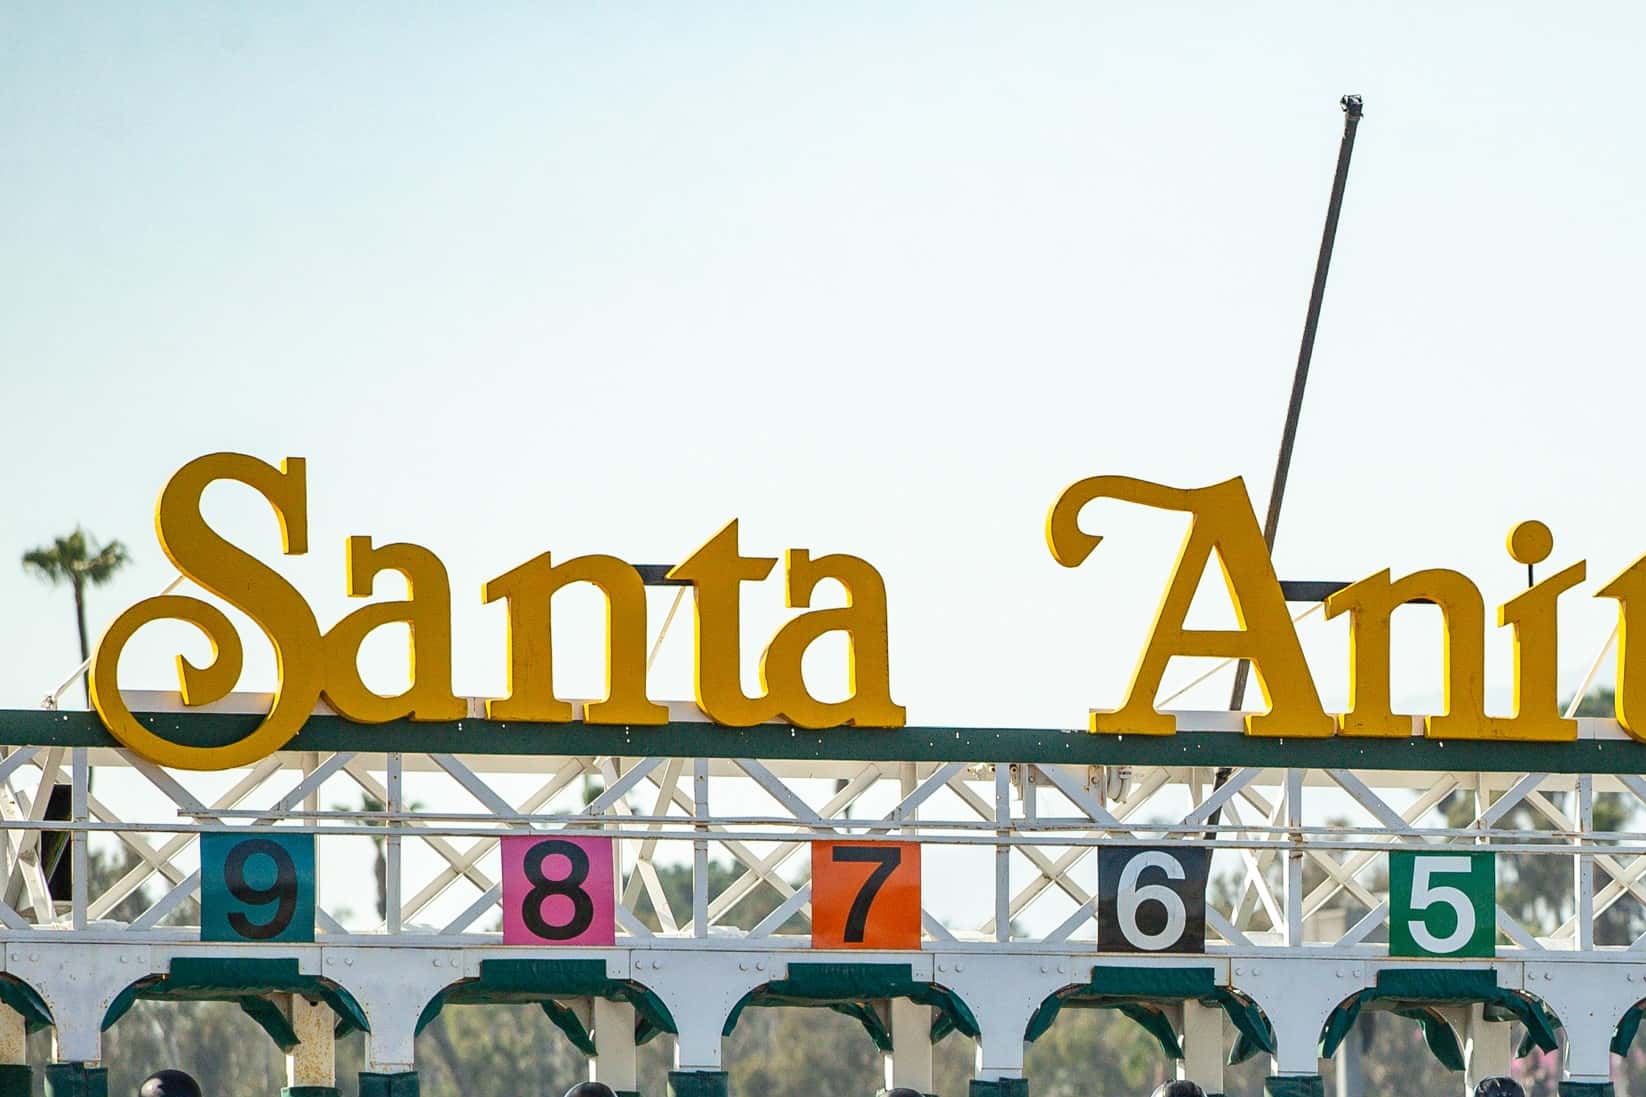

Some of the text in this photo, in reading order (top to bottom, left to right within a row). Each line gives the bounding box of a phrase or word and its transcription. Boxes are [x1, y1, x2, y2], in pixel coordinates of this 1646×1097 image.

[88, 452, 907, 772] Santa
[223, 839, 297, 940] 9
[521, 839, 594, 941] 8
[831, 845, 902, 944] 7
[1116, 850, 1187, 951] 6
[1408, 856, 1476, 953] 5
